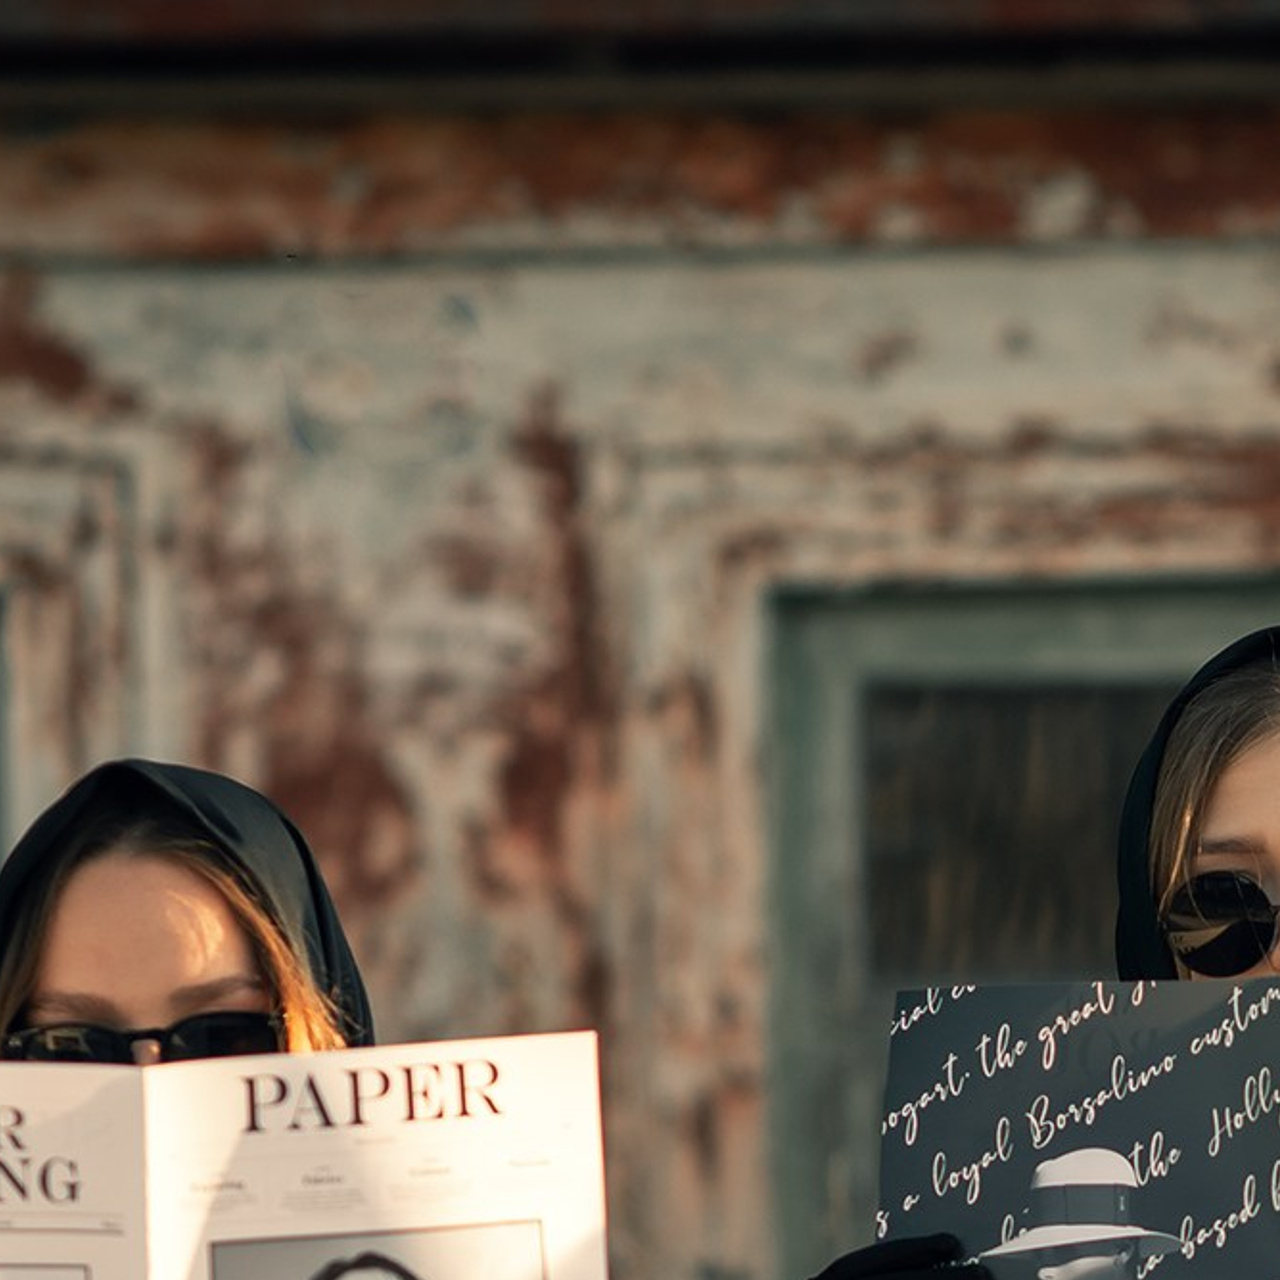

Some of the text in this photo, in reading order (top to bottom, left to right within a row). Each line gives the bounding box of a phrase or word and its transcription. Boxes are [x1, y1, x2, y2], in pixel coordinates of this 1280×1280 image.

[976, 1023, 1028, 1078] the
[241, 1059, 501, 1133] PAPER
[932, 1116, 1013, 1205] loyal
[1025, 1055, 1177, 1150] Borsalino
[1128, 1131, 1181, 1187] the
[1180, 1174, 1261, 1259] based
